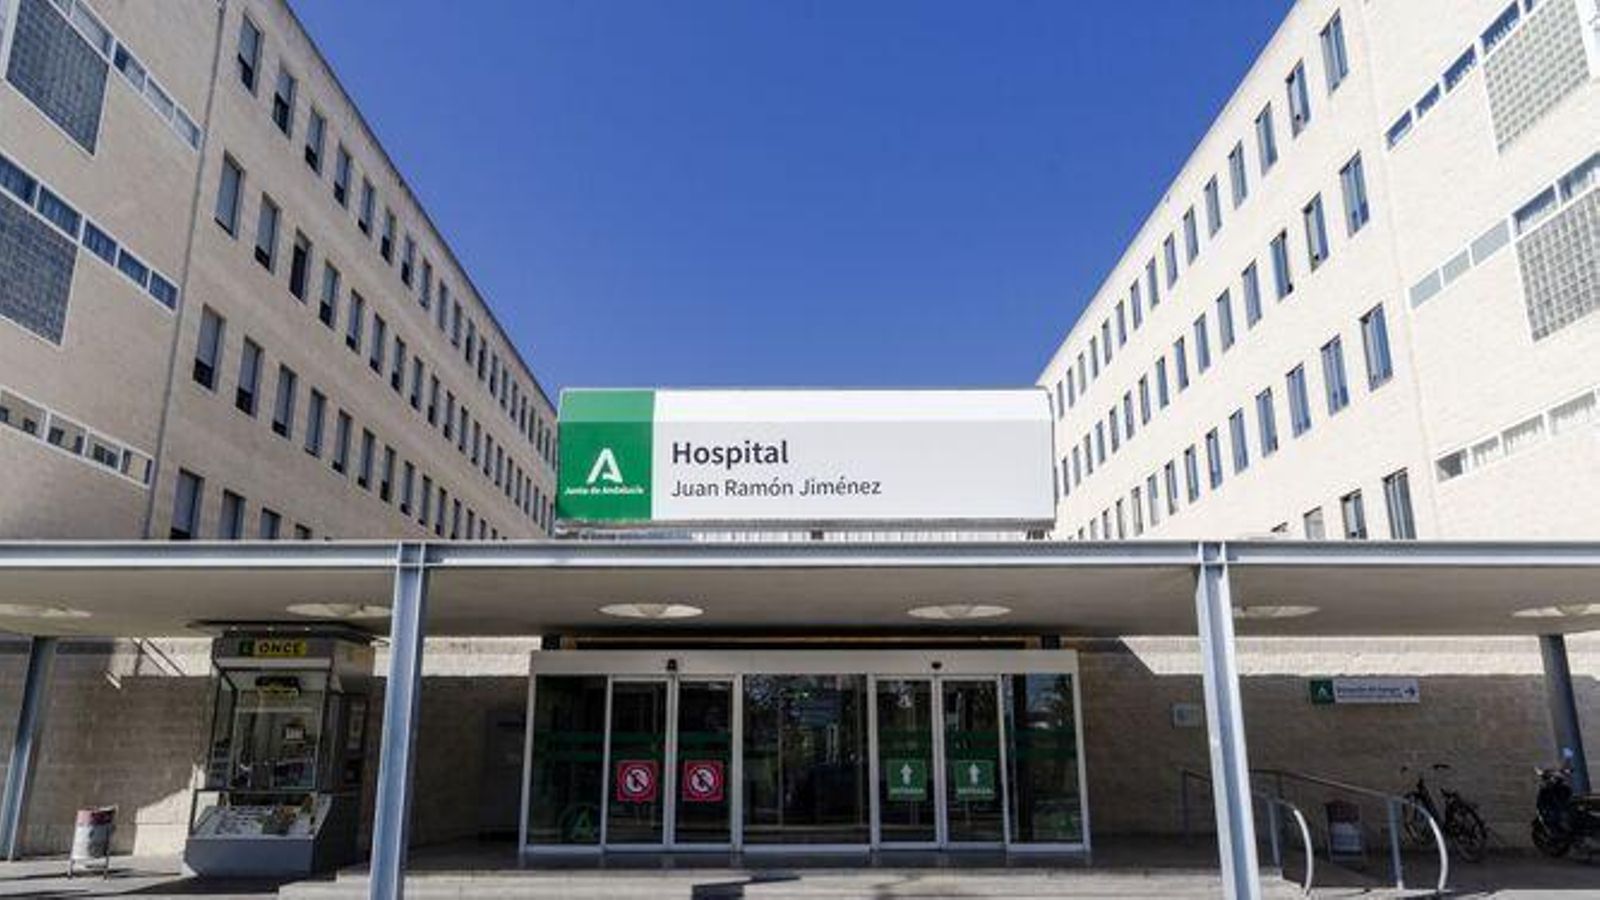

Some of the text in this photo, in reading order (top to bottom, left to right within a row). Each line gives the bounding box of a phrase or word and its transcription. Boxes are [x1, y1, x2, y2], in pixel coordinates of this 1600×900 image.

[672, 440, 789, 470] Hospital
[671, 476, 881, 497] Juan Ramón Jiménez
[258, 641, 299, 654] ONCE
